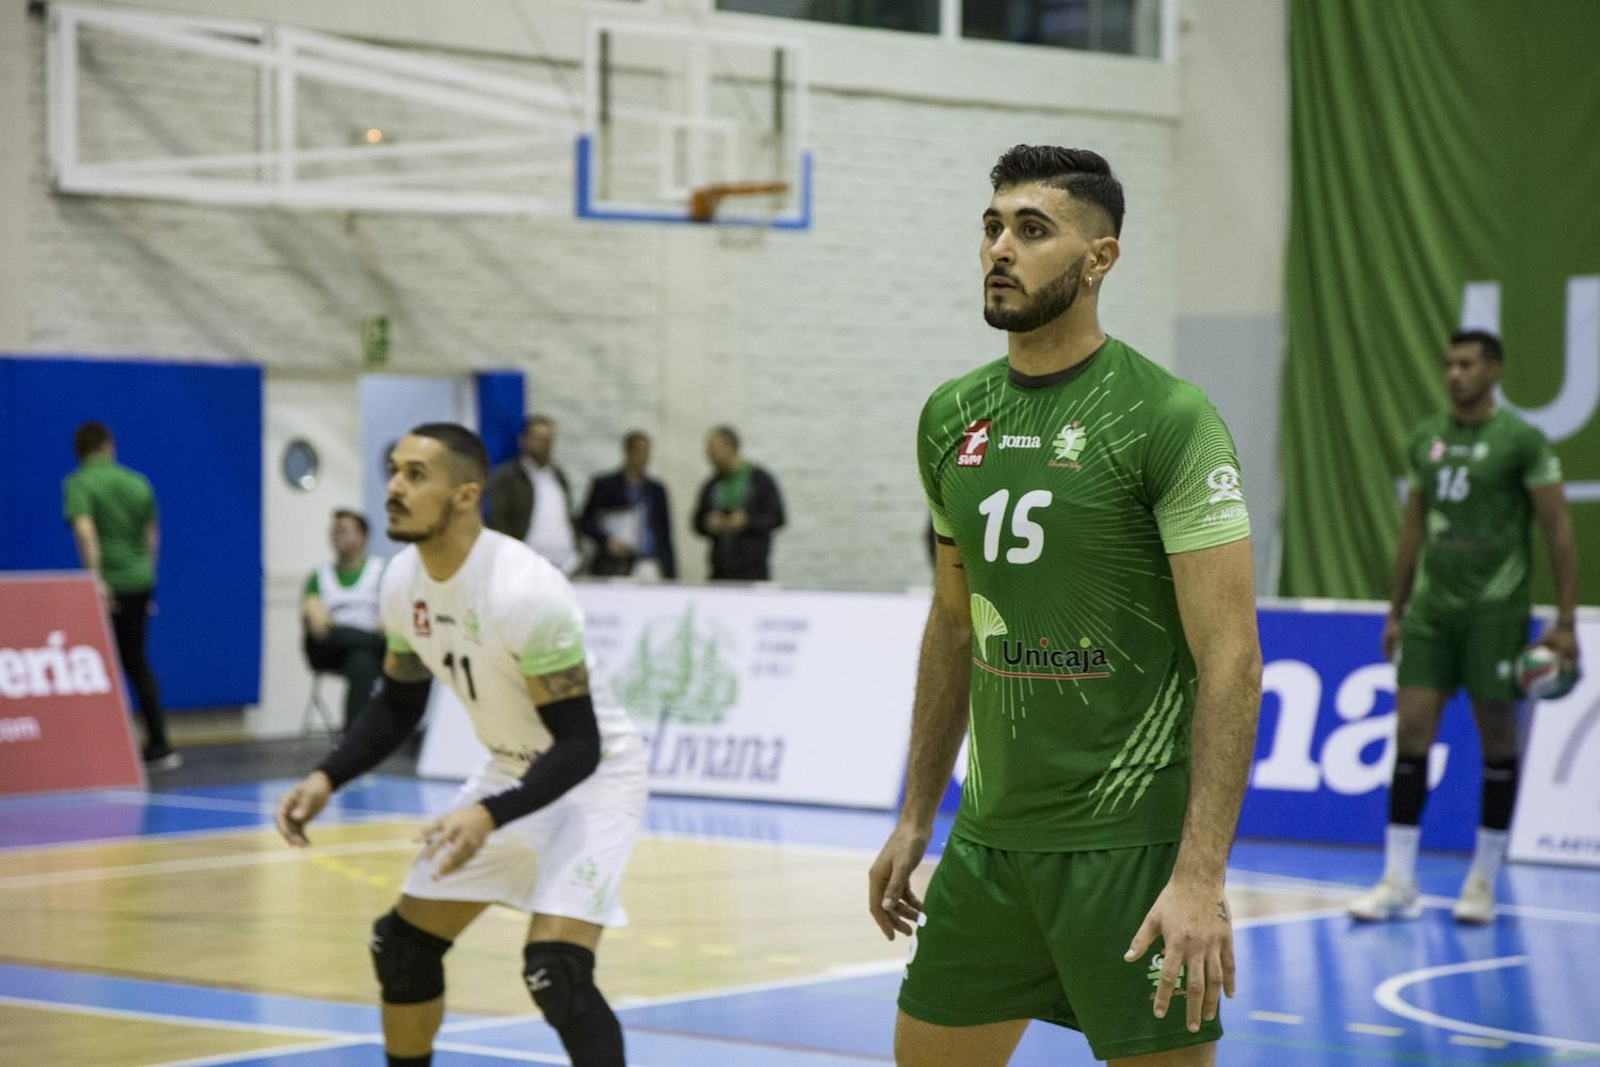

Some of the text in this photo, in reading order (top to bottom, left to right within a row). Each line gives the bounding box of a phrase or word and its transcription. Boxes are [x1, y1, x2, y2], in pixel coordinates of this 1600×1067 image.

[1436, 466, 1470, 502] 16
[979, 489, 1053, 564] 15
[442, 652, 476, 700] 11
[1003, 637, 1107, 673] Unicaja
